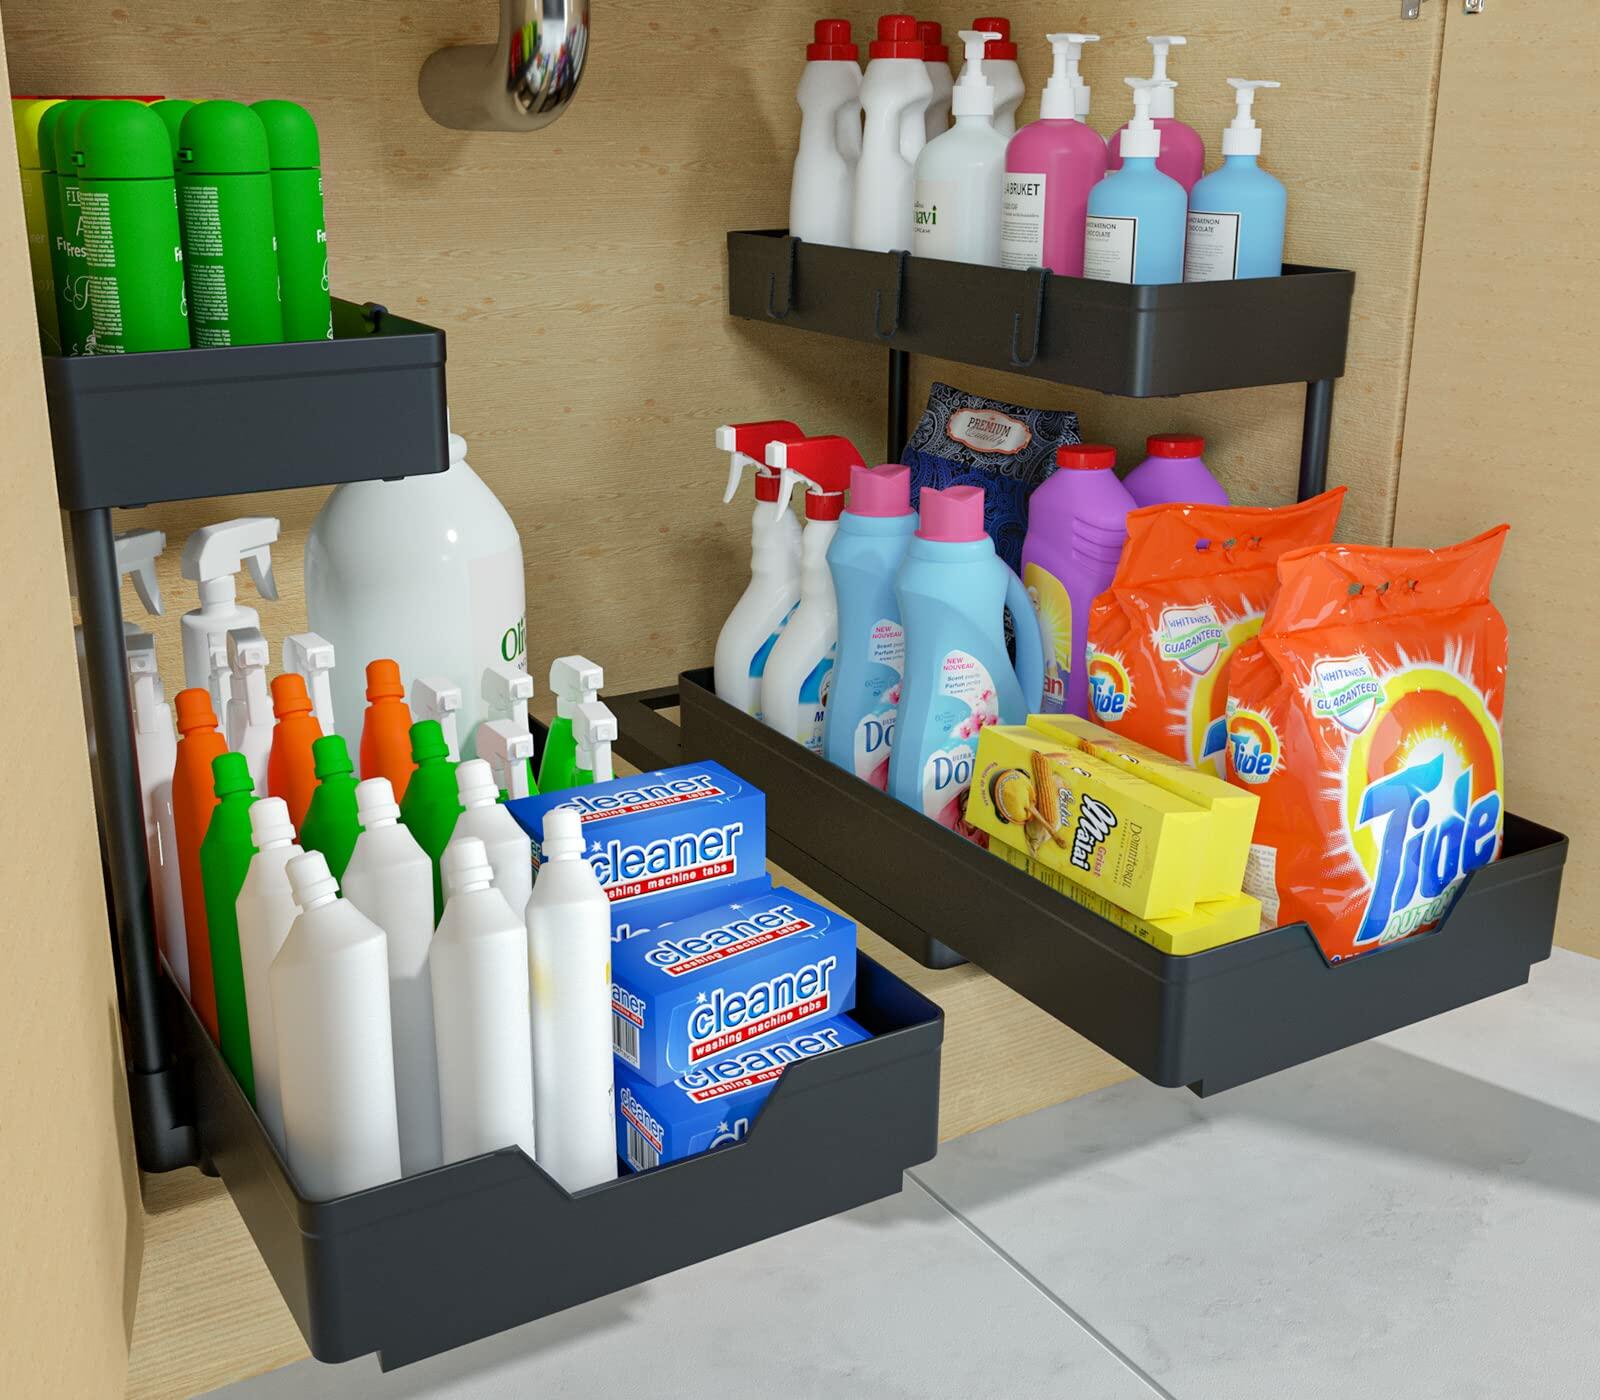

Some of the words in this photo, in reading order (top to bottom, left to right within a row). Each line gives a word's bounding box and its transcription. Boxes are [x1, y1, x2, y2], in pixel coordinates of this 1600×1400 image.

[967, 417, 1011, 437] PREMIUM
[1164, 629, 1221, 653] GUARANTEED
[943, 663, 974, 671] NOUVEAU
[1231, 733, 1273, 776] Tide
[632, 796, 682, 811] machine
[686, 789, 713, 800] tabs
[588, 822, 743, 886] cleaner
[1356, 751, 1501, 944] Tide
[608, 882, 641, 900] shing
[647, 865, 697, 890] machine
[702, 863, 728, 877] tabs
[645, 904, 798, 968] cleaner
[671, 950, 723, 974] washing
[726, 933, 774, 954] machine
[776, 922, 802, 937] tabs
[612, 983, 647, 1018] aner
[687, 955, 837, 1042] cleaner
[695, 1031, 743, 1056] washing
[747, 1009, 793, 1035] machine
[798, 999, 822, 1016] tabs
[698, 1077, 752, 1098] washing
[621, 1087, 665, 1143] cleaner
